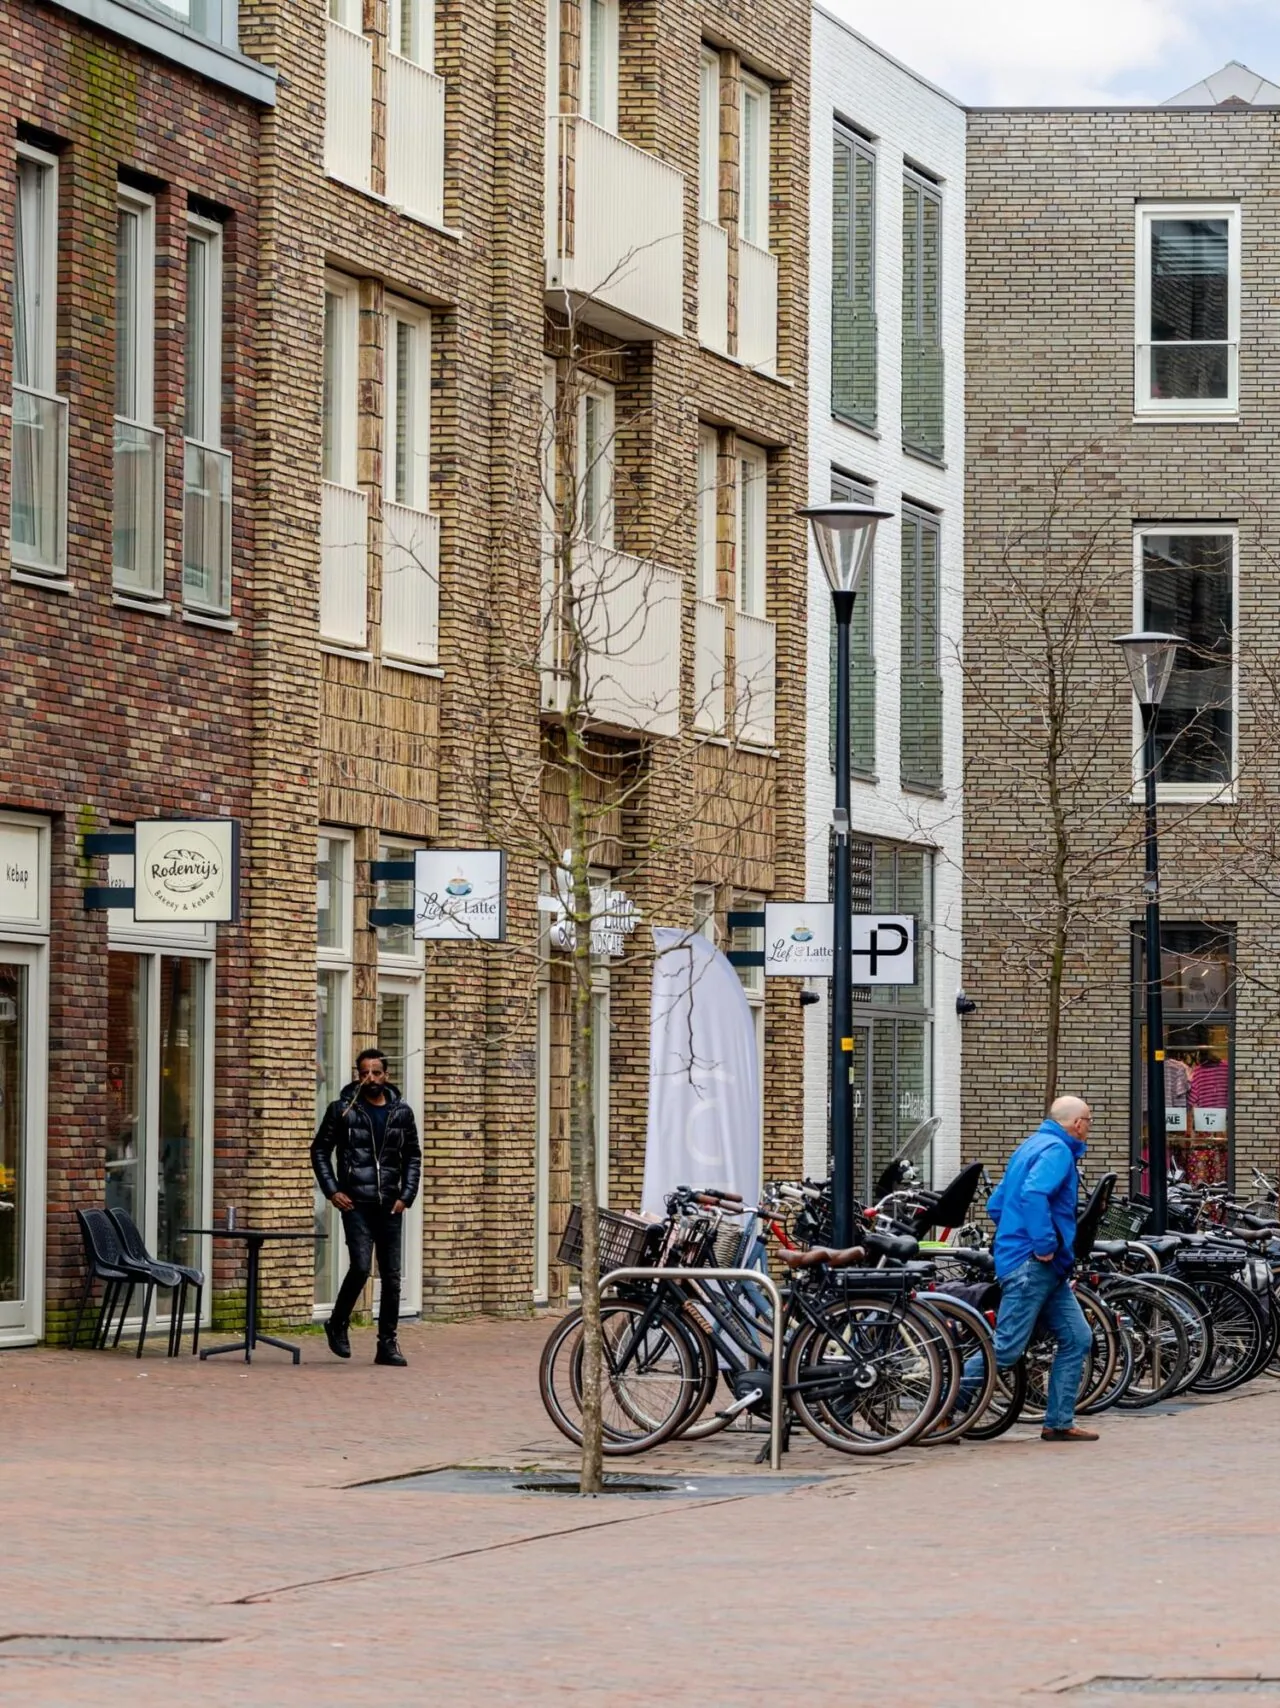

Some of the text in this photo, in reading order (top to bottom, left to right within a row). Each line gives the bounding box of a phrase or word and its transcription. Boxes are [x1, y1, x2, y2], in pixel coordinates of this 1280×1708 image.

[151, 861, 218, 880] Rodenrijs
[464, 901, 496, 914] Latte
[767, 938, 793, 962] Lief
[1166, 1116, 1181, 1125] ALE
